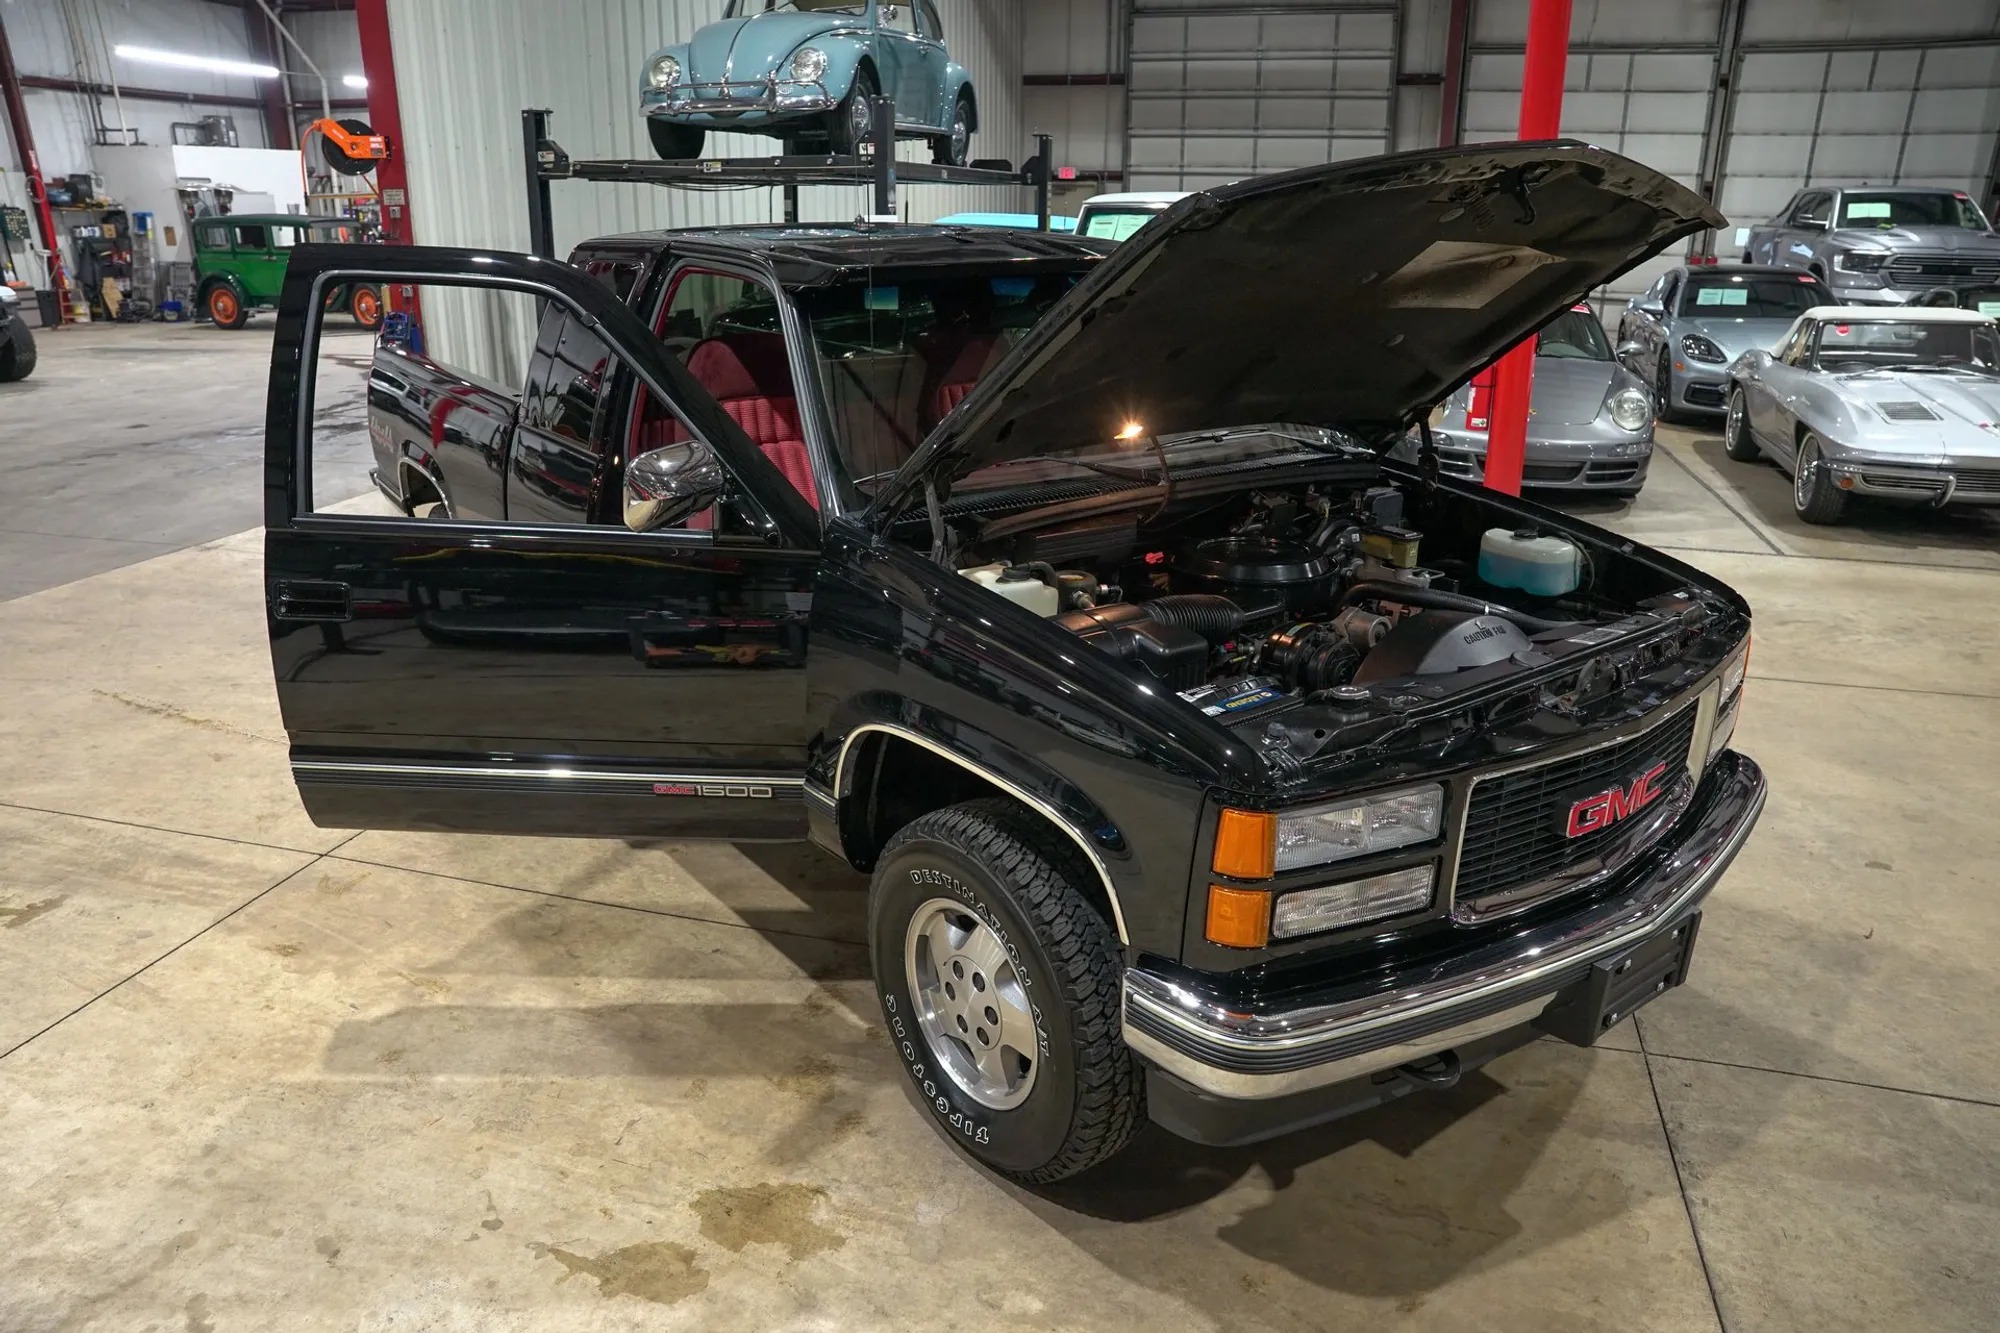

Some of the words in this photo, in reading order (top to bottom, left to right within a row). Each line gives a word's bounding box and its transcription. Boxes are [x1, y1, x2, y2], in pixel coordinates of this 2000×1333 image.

[1463, 628, 1494, 645] CAUTION
[652, 783, 695, 795] GMC
[695, 785, 772, 798] 1500
[1566, 760, 1666, 838] GMC
[910, 869, 1032, 986] DESTINATION
[1032, 1004, 1050, 1057] A/T
